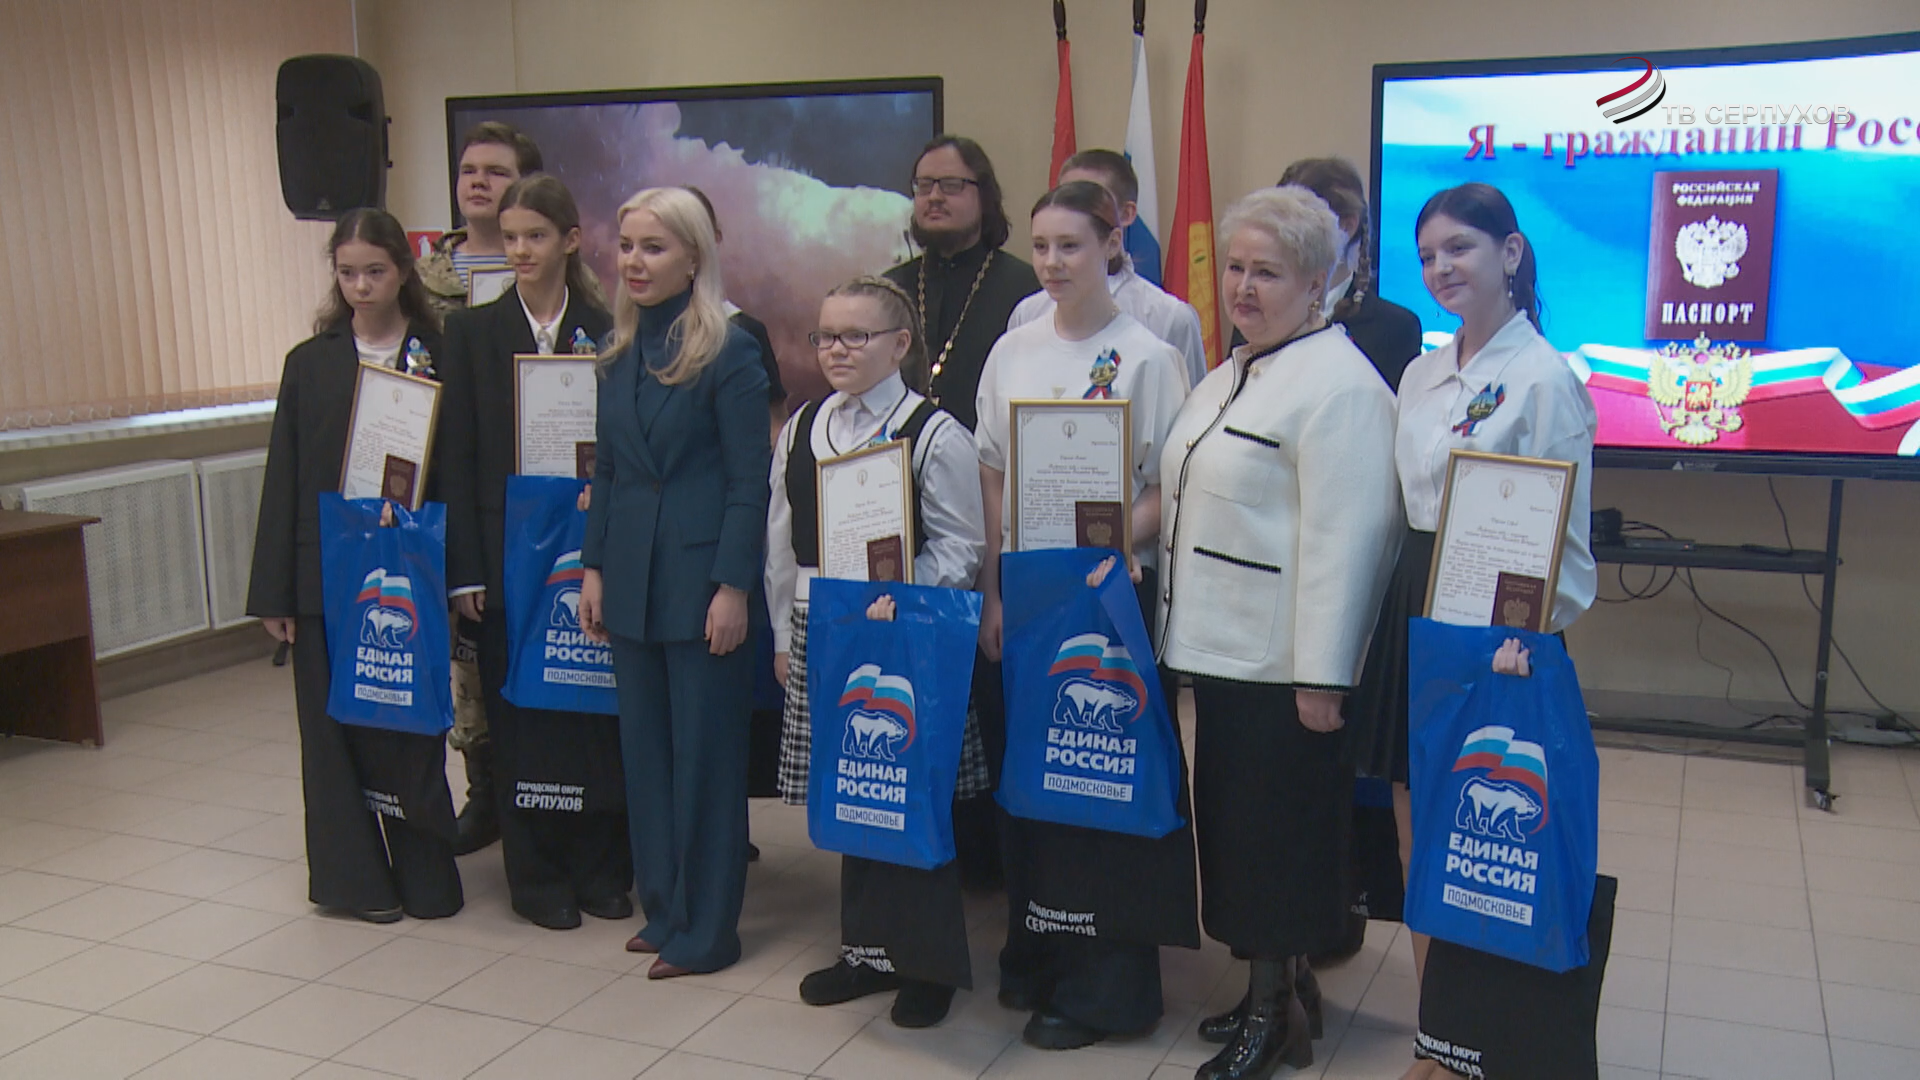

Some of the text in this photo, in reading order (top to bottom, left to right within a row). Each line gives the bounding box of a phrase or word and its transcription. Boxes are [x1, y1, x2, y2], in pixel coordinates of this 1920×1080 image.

[1464, 122, 1498, 160] Я
[1542, 122, 1804, 169] гражданин
[1826, 108, 1920, 152] Рос
[1672, 180, 1760, 194] РОССИЙСКАЯ
[1676, 193, 1754, 208] ФЕДЕРАЦИЯ
[1661, 302, 1754, 325] ПАСПОРТ
[546, 629, 612, 649] ЕДИН
[1047, 728, 1136, 755] ЕДИНАЯ
[838, 758, 908, 784] ЕДИНАЯ
[1046, 746, 1135, 775] РОССИЯ
[836, 776, 906, 804] РОССИЯ
[1048, 776, 1127, 799] ПОДМОСКОВЬЕ
[515, 793, 583, 812] СЕРПУХОВ
[839, 806, 900, 828] ПОДМОСКОВЬЕ
[1448, 831, 1539, 871] ЕДИНАЯ
[1445, 853, 1537, 895] РОССИЯ
[1447, 888, 1527, 921] ПОДМОСКОВЬЕ
[1452, 1045, 1482, 1062] ОКРУГ
